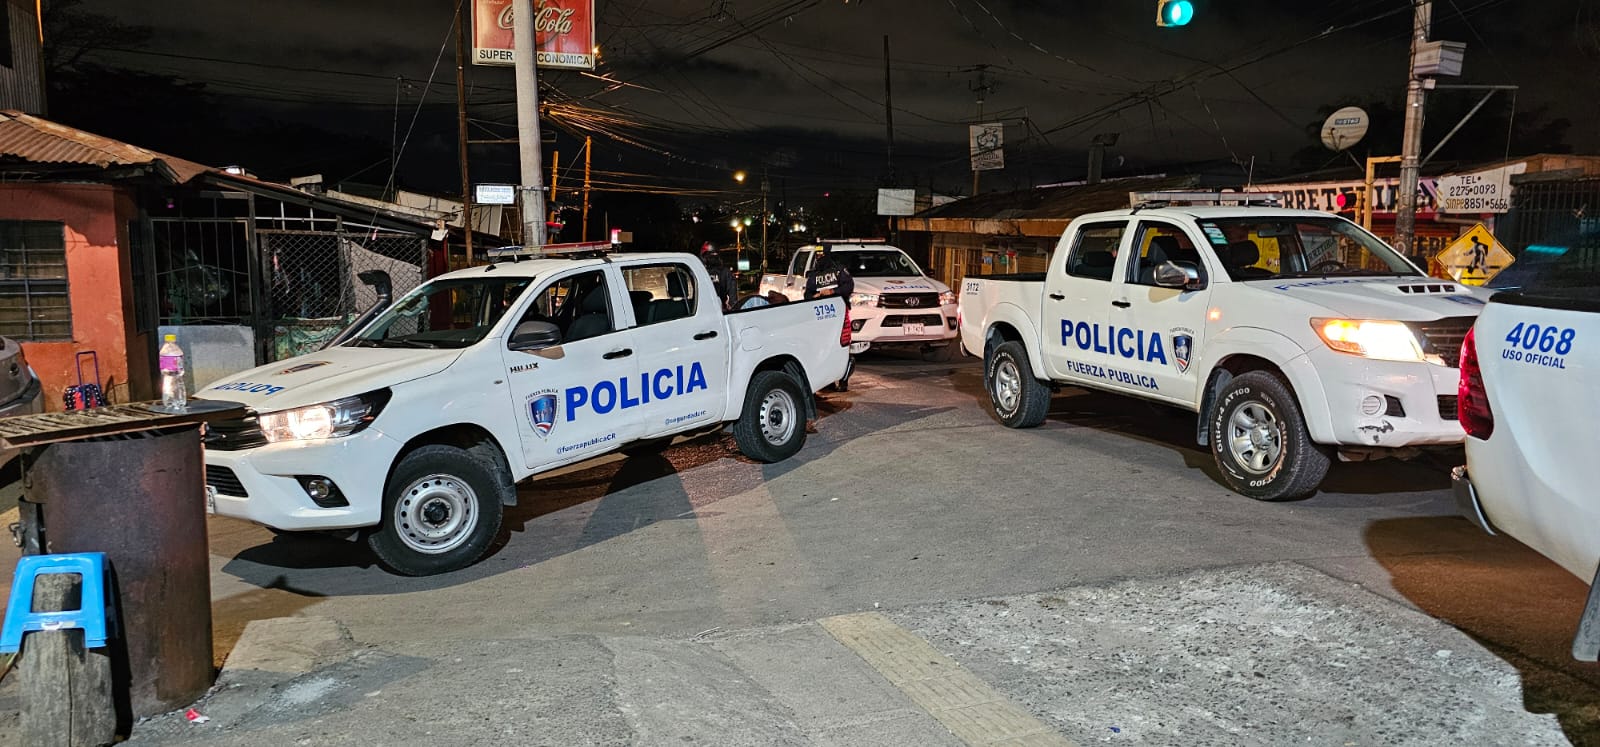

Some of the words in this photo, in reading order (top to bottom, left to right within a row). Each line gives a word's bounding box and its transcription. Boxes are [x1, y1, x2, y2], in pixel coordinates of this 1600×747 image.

[479, 49, 513, 60] SUPER
[537, 53, 590, 65] CONOMICA
[815, 272, 837, 285] POLICIA
[814, 303, 836, 316] 3794
[1060, 318, 1168, 365] POLICIA
[1505, 322, 1576, 355] 4068
[510, 362, 539, 374] HILUX
[1502, 348, 1522, 361] USO
[1525, 353, 1566, 369] OFICIAL
[1066, 359, 1106, 379] FUERZA
[1108, 368, 1159, 390] PUBLICA
[565, 361, 708, 422] POLICIA
[1225, 387, 1250, 406] AT100
[556, 432, 616, 454] @fuerzapublicaCR
